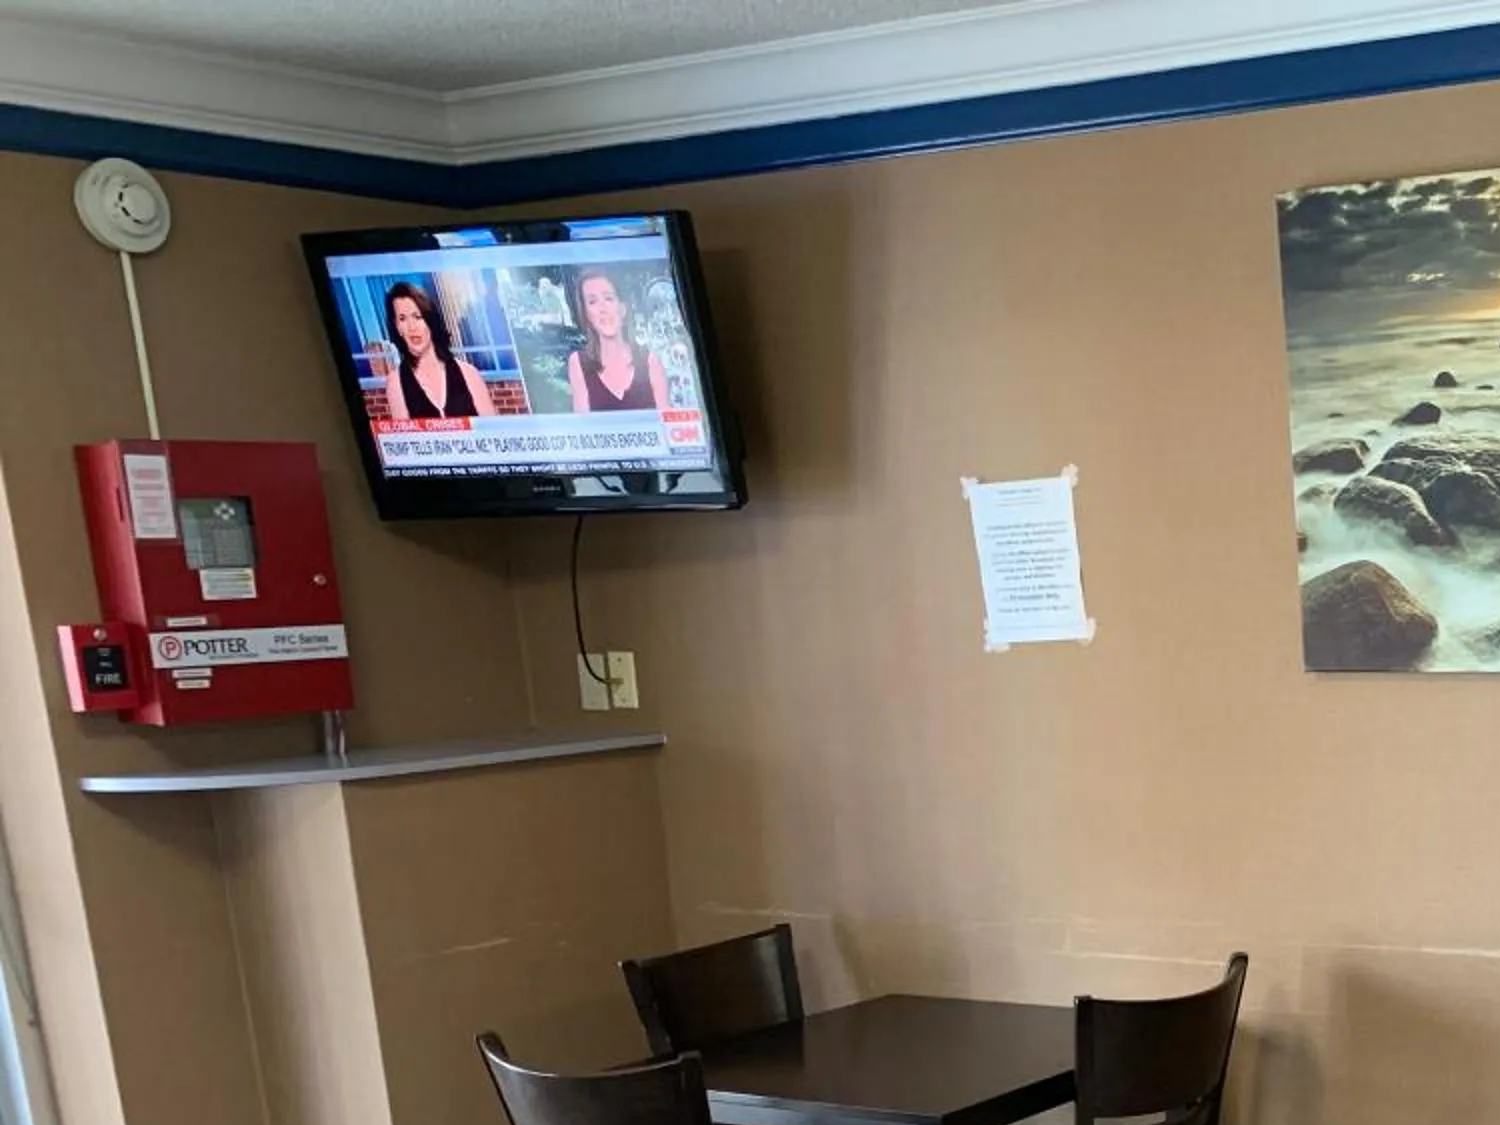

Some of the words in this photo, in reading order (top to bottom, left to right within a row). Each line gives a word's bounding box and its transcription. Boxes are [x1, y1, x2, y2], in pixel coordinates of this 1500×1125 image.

[380, 420, 425, 431] GLOBAL
[670, 427, 700, 442] CNN
[273, 634, 298, 644] PFC
[300, 632, 329, 643] Series
[183, 637, 250, 657] POTTER
[95, 673, 121, 685] FIRE
